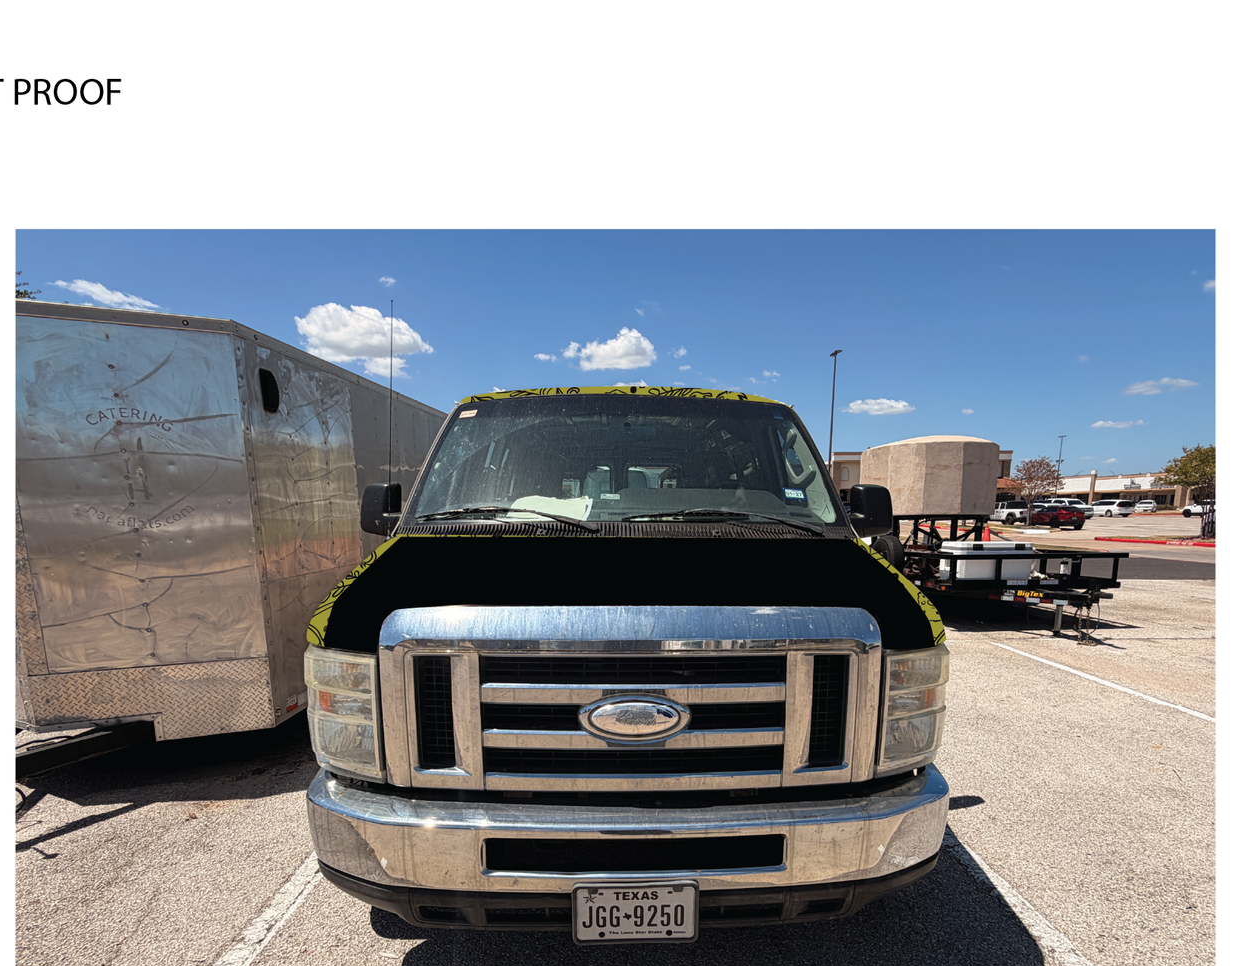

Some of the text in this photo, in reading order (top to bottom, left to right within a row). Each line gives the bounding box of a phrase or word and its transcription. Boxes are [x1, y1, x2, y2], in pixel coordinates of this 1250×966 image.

[85, 407, 174, 432] CATERING
[613, 890, 659, 901] TEXAS
[582, 904, 685, 928] JGG 9250
